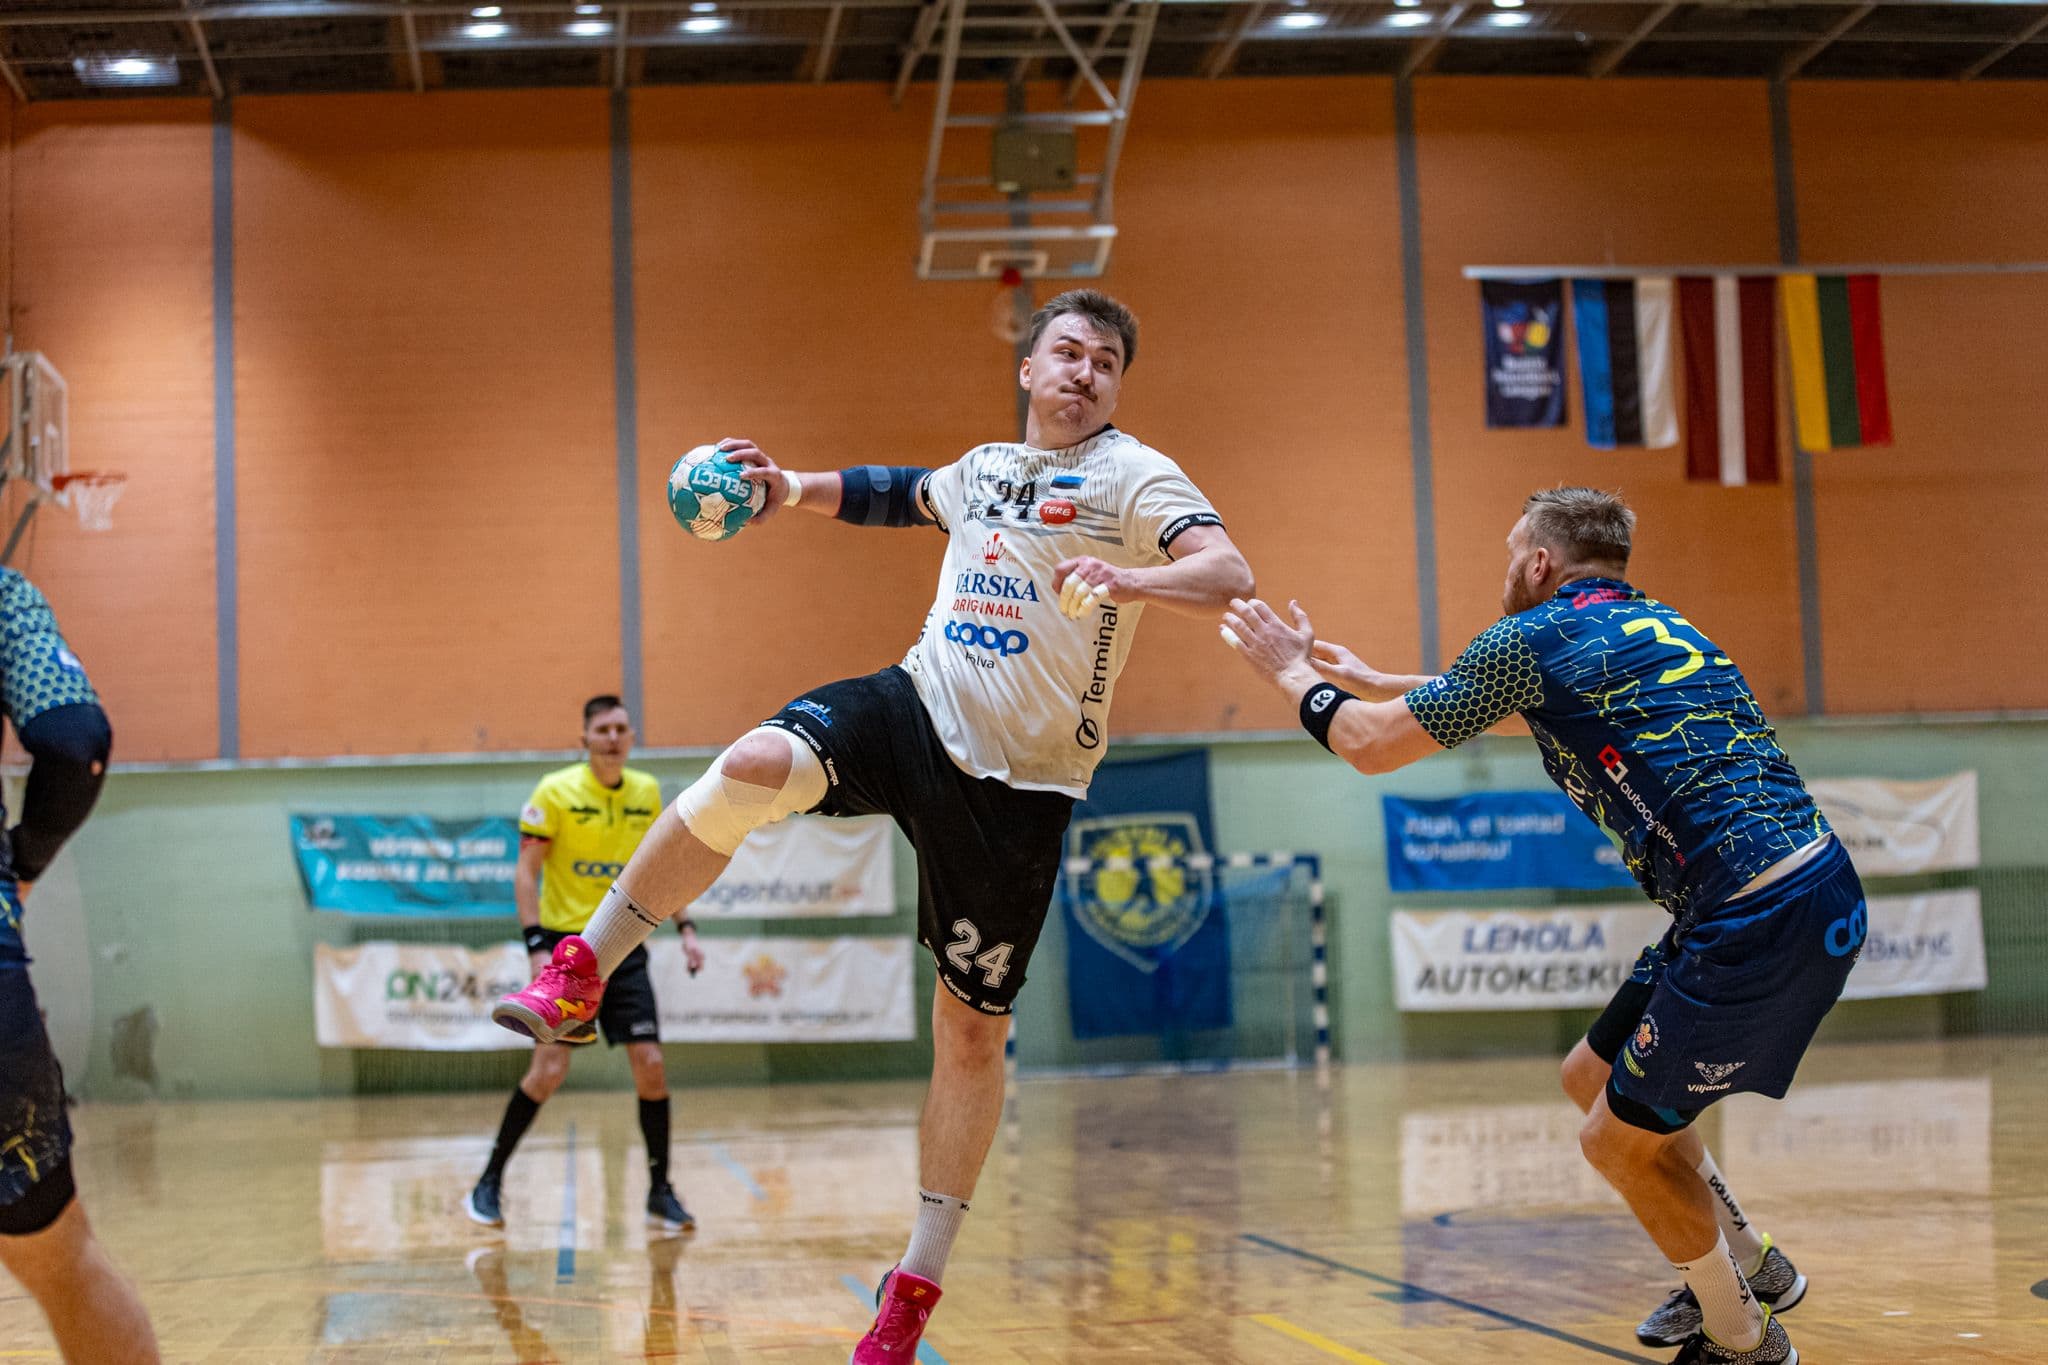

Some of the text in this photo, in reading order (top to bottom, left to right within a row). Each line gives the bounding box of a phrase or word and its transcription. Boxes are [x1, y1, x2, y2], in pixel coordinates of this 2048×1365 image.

[691, 468, 751, 498] SELECT
[986, 479, 1037, 521] 24
[1043, 505, 1072, 517] TERE
[1162, 517, 1191, 542] Kempa
[952, 598, 1024, 620] ORIGINAAL
[944, 620, 1029, 658] coop
[1081, 603, 1118, 704] Terminal
[792, 723, 823, 752] Kempa
[824, 757, 840, 787] Kempa
[573, 861, 624, 877] coo
[944, 918, 1015, 989] 24
[943, 974, 972, 1002] Kempa
[1687, 1082, 1732, 1095] Viljandi
[1708, 1174, 1748, 1232] Kempa
